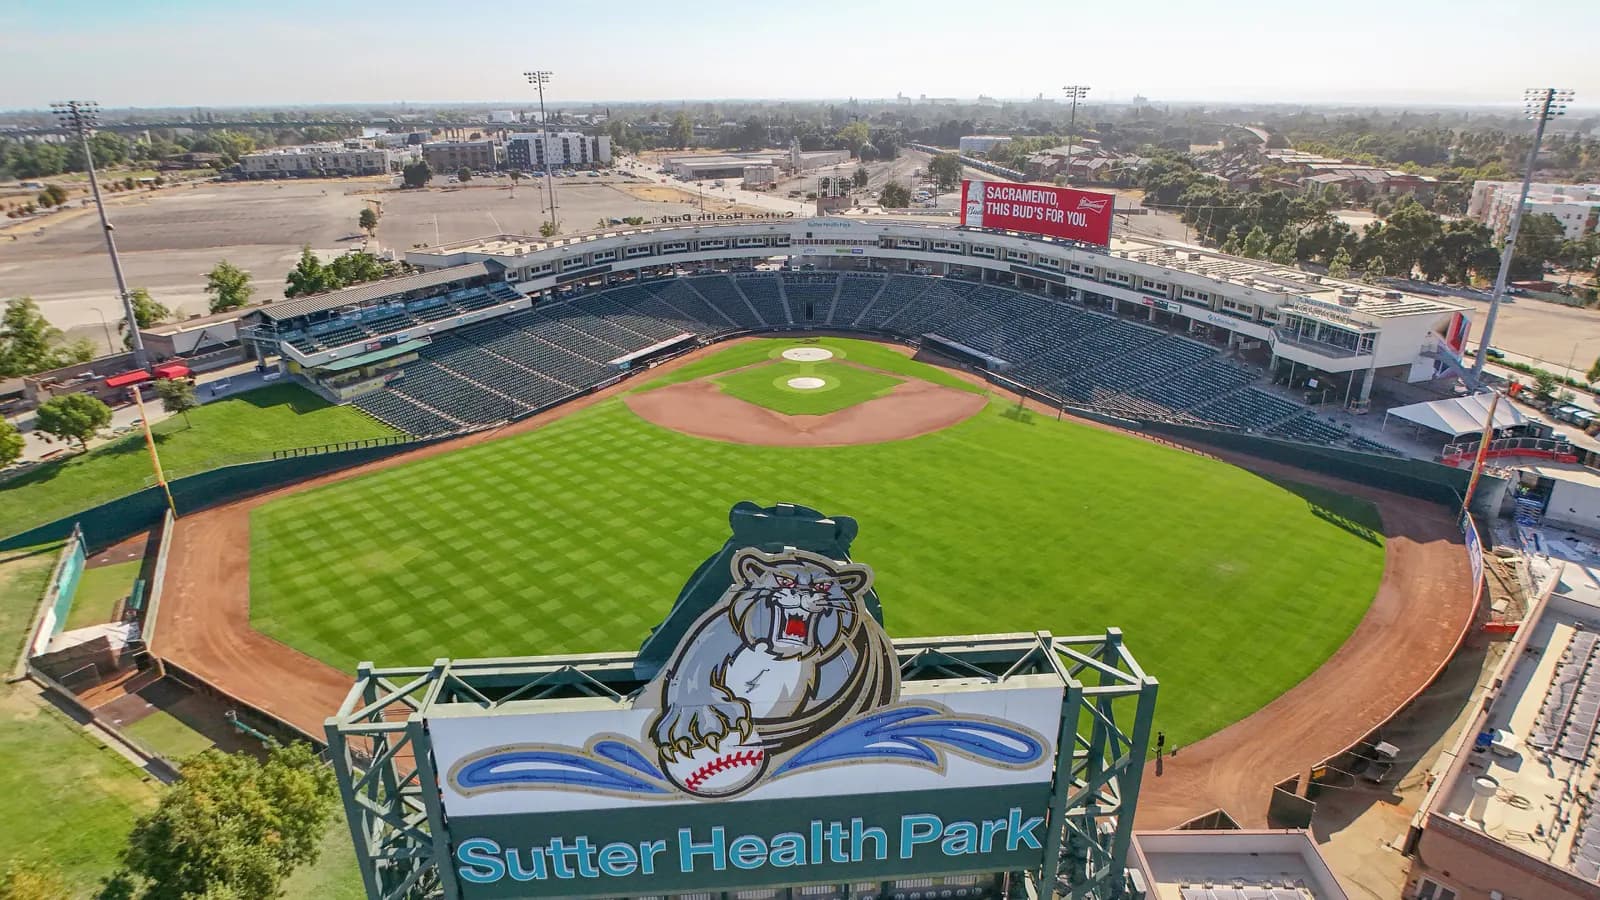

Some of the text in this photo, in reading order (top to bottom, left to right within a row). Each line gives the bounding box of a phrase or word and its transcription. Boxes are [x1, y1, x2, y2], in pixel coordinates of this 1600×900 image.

[986, 186, 1059, 208] SACRAMENTO,
[986, 202, 1088, 227] THIS BUD'S FOR YOU.
[457, 806, 1045, 883] Sutter Health Park
